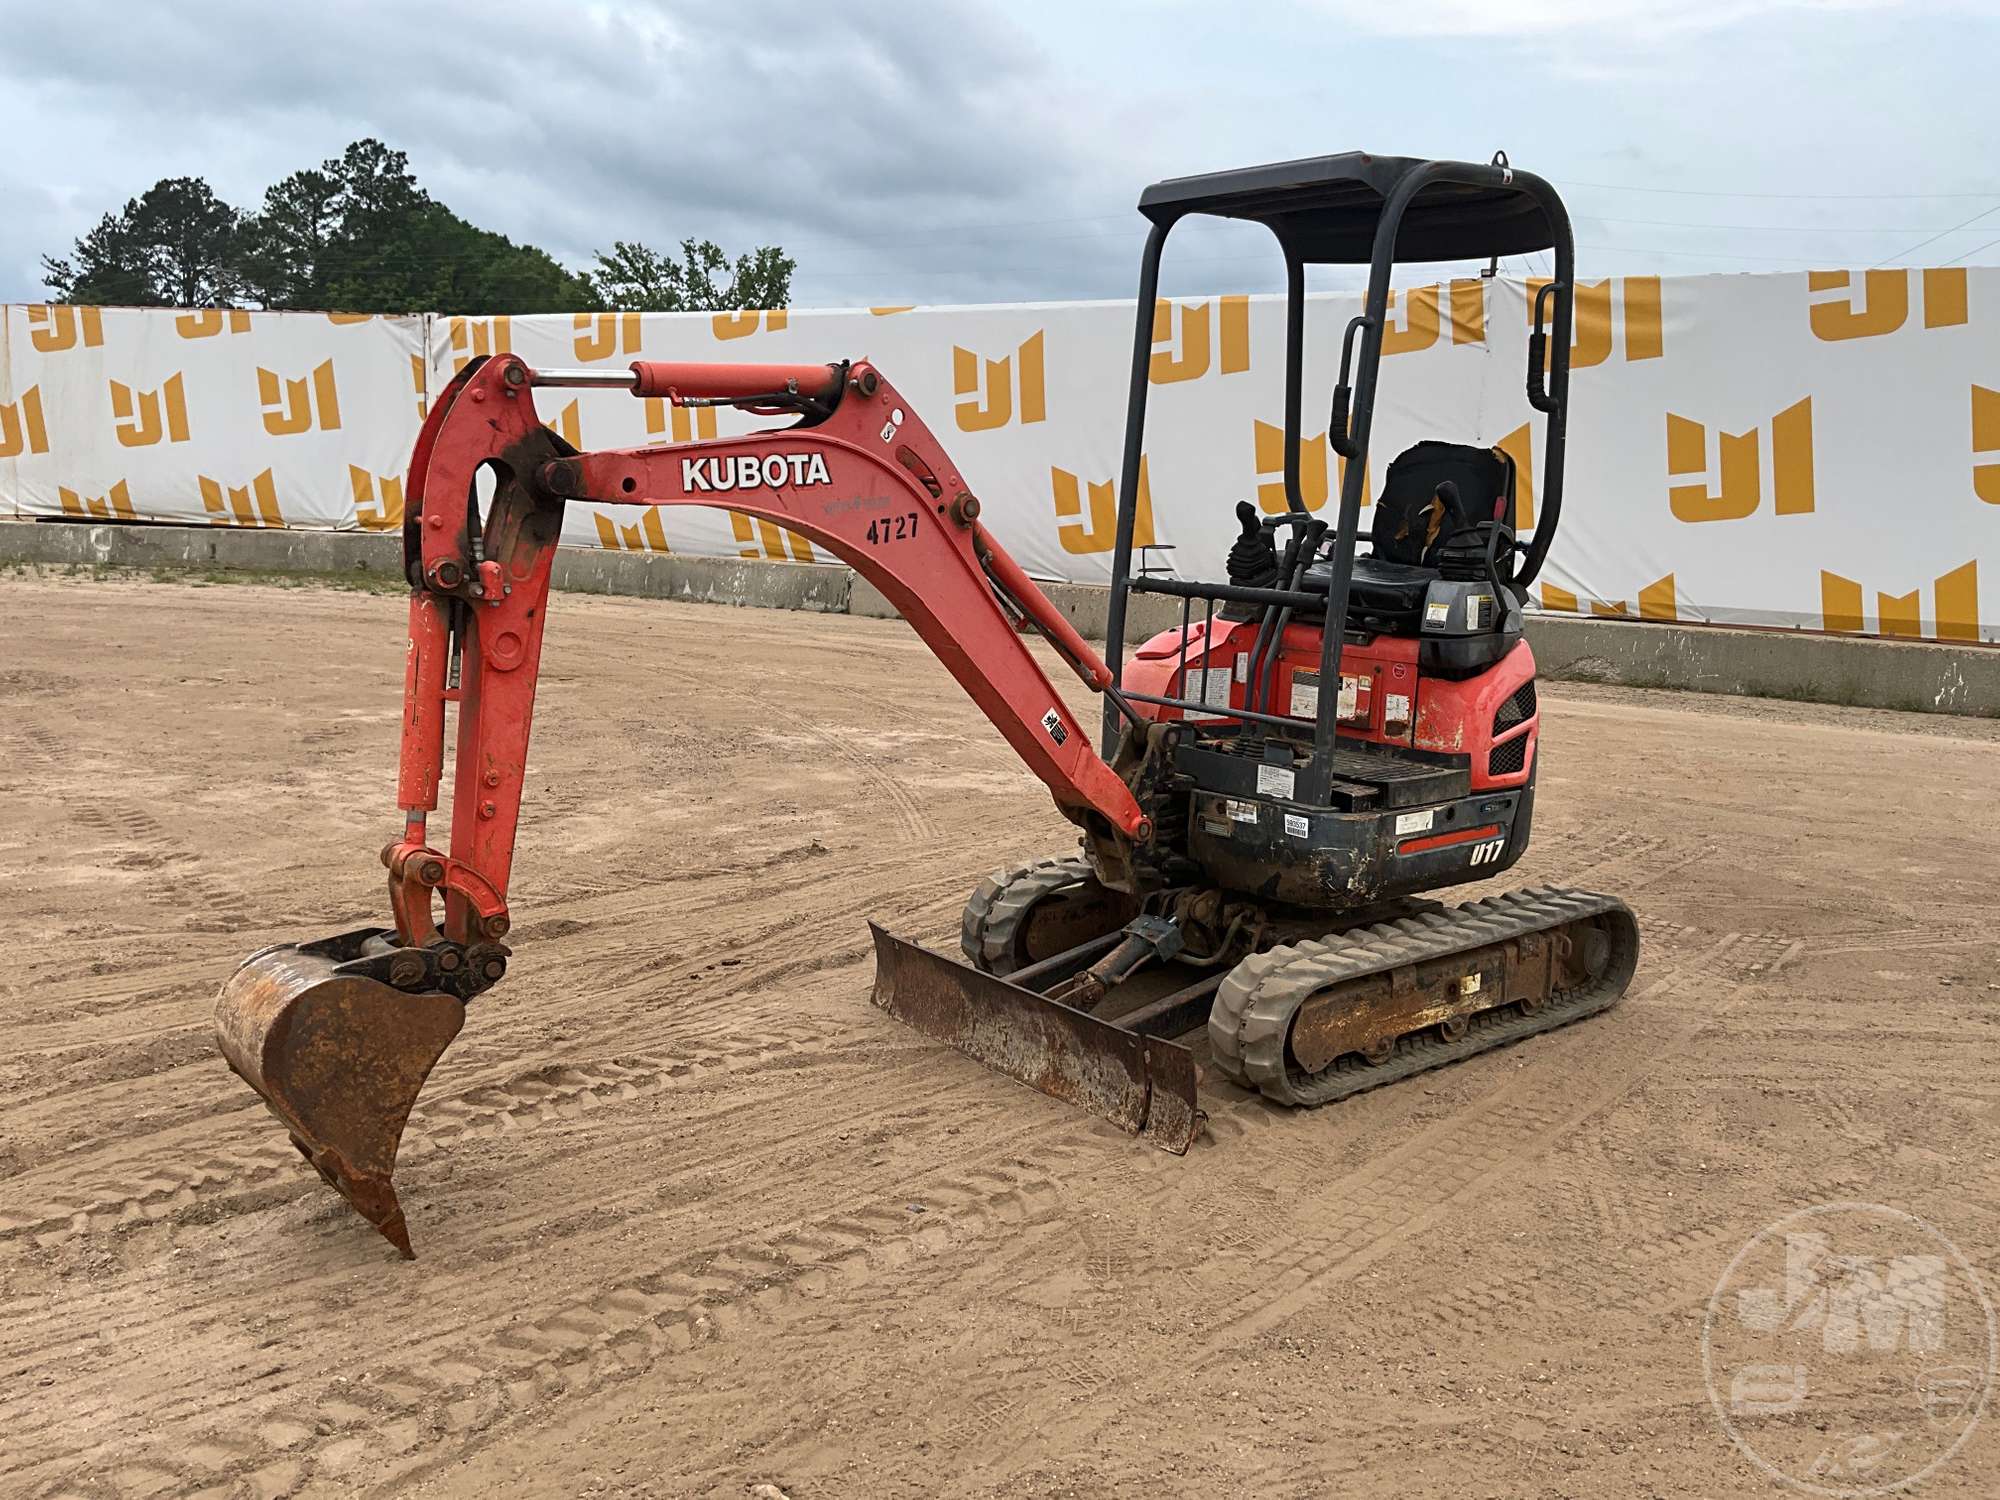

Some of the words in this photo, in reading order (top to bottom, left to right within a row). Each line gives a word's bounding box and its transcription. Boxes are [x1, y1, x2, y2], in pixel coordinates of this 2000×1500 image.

[681, 453, 832, 492] KUBOTA
[866, 513, 918, 545] 4727
[1469, 838, 1504, 866] U17
